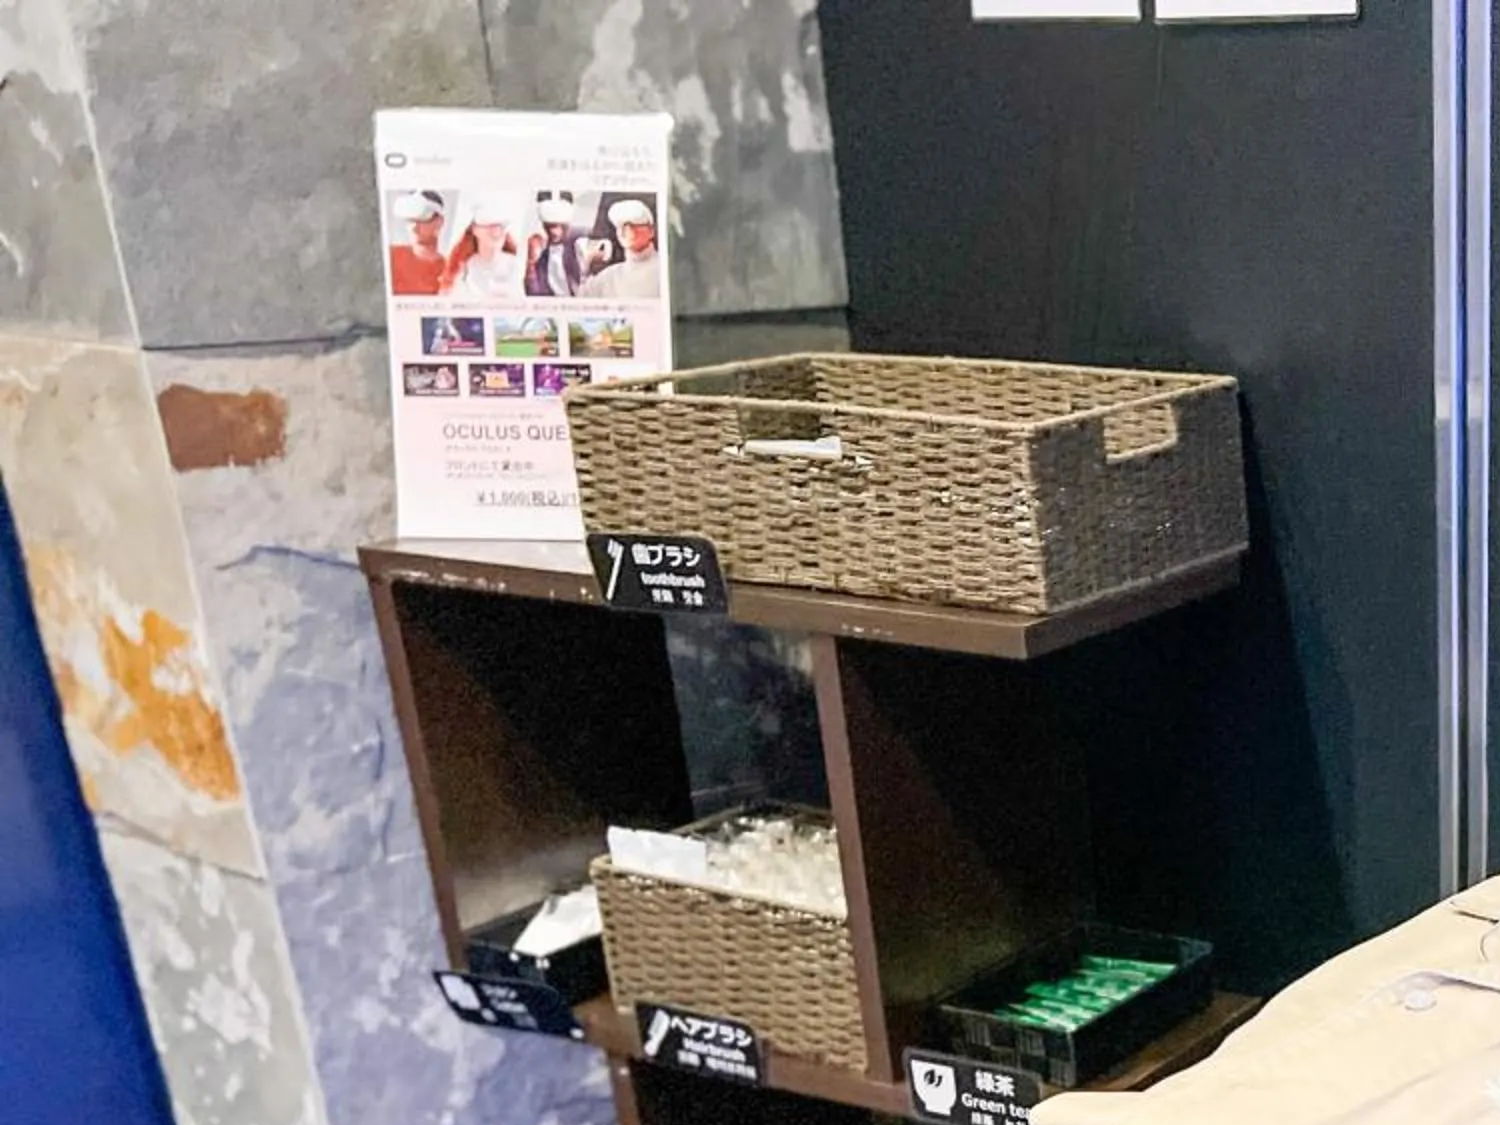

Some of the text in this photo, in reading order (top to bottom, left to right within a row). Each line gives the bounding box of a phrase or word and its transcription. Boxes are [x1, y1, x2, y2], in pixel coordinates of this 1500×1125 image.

[443, 424, 521, 440] OCULUS
[671, 1016, 752, 1047] ヘアブラシ
[961, 1093, 1006, 1115] Green
